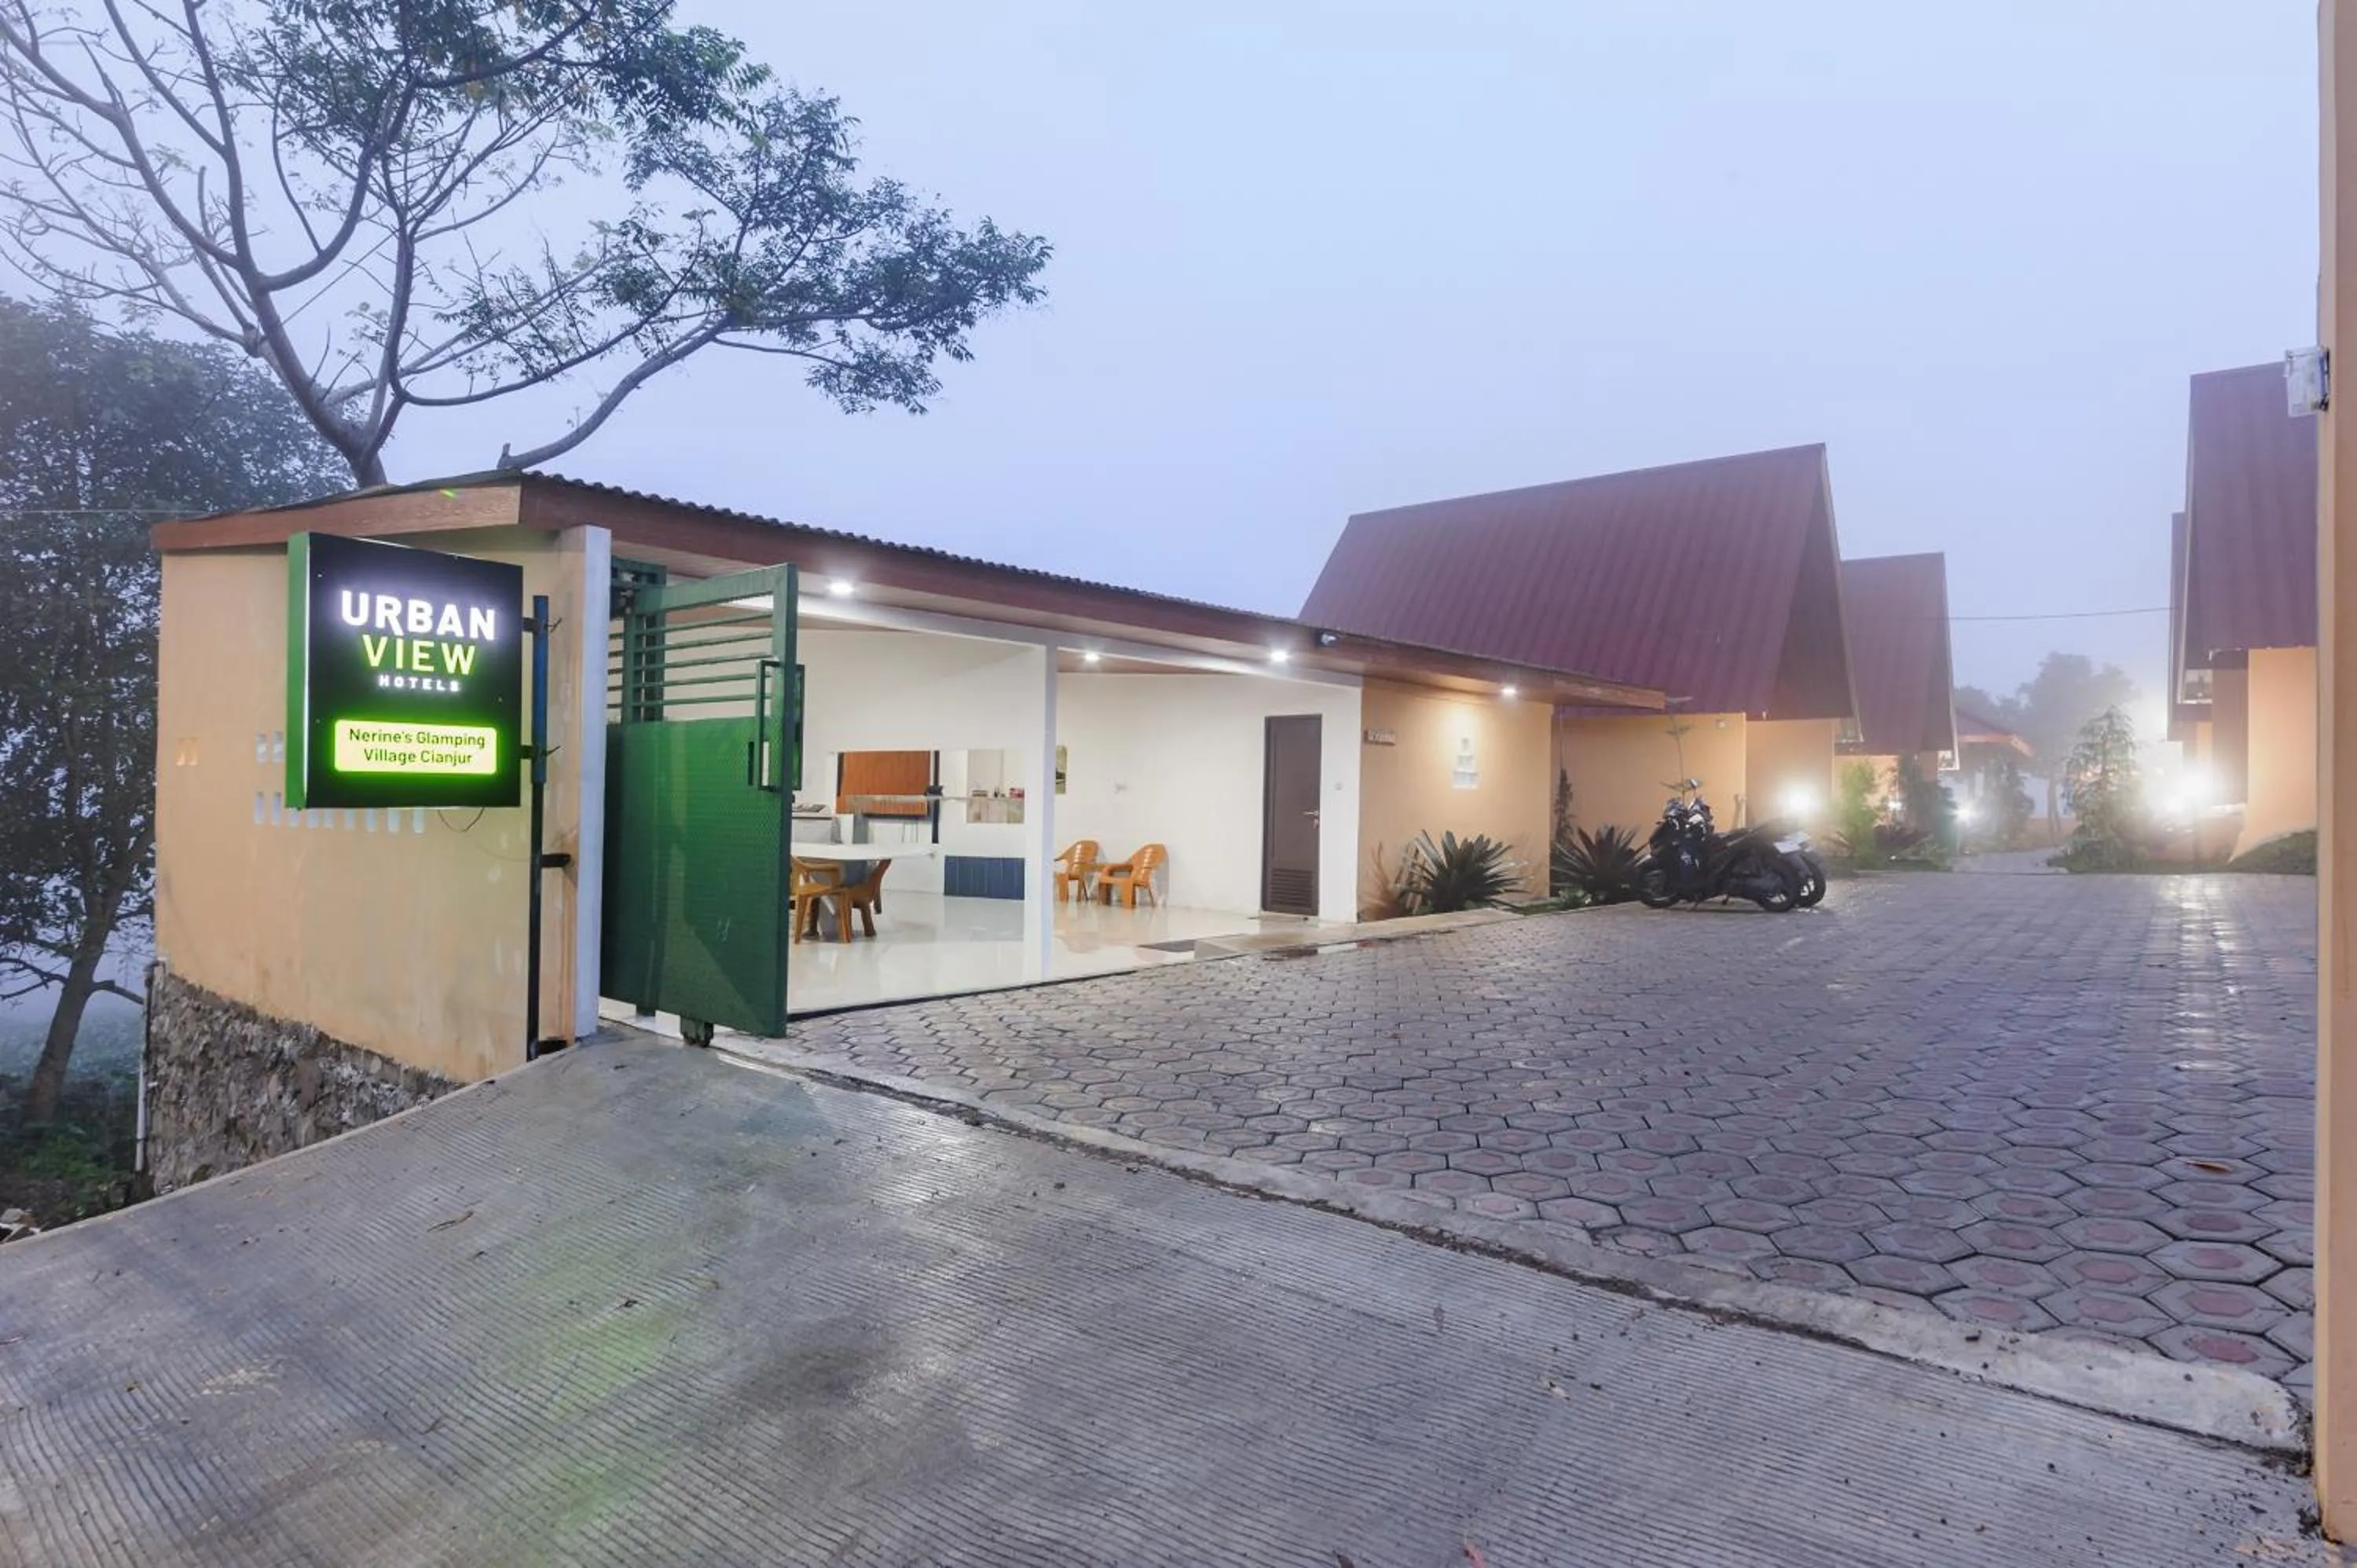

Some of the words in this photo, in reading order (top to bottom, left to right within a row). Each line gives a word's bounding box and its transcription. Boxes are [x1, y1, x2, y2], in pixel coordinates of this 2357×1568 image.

[341, 590, 496, 641] URBAN
[361, 634, 476, 676] VIEW
[378, 675, 462, 693] HOTELS
[349, 728, 413, 744] Nerine's
[416, 731, 486, 749] Glamping
[363, 749, 416, 765] Village
[420, 750, 472, 767] Cianjur
